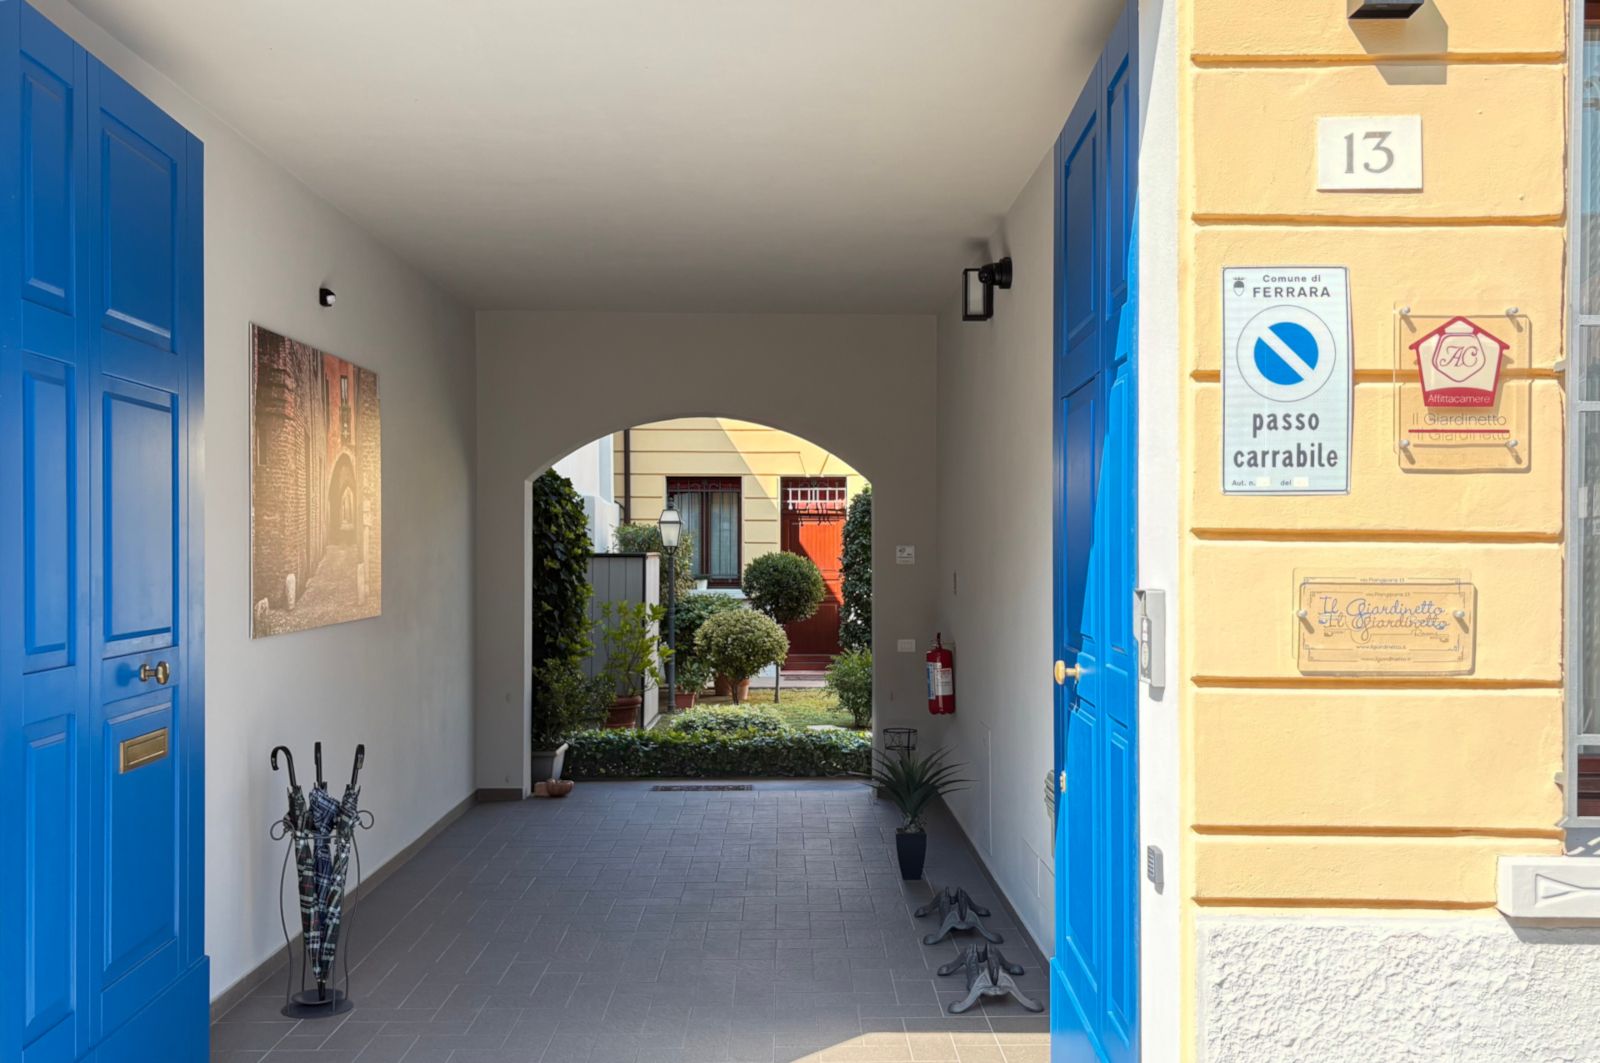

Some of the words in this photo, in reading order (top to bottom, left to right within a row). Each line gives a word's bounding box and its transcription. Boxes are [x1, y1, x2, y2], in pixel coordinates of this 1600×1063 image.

[1343, 131, 1395, 174] 13
[1262, 274, 1307, 283] Comune
[1311, 274, 1321, 283] di
[1252, 286, 1331, 298] FERRARA
[1427, 394, 1491, 404] Affittacamere
[1252, 412, 1320, 438] passo
[1412, 413, 1419, 426] Il
[1423, 412, 1507, 426] Giardinetto
[1233, 442, 1339, 468] carrabile
[1231, 479, 1247, 487] Aut.
[1280, 479, 1292, 487] del
[1319, 595, 1339, 614] Il
[1345, 597, 1446, 629] Giardinetto
